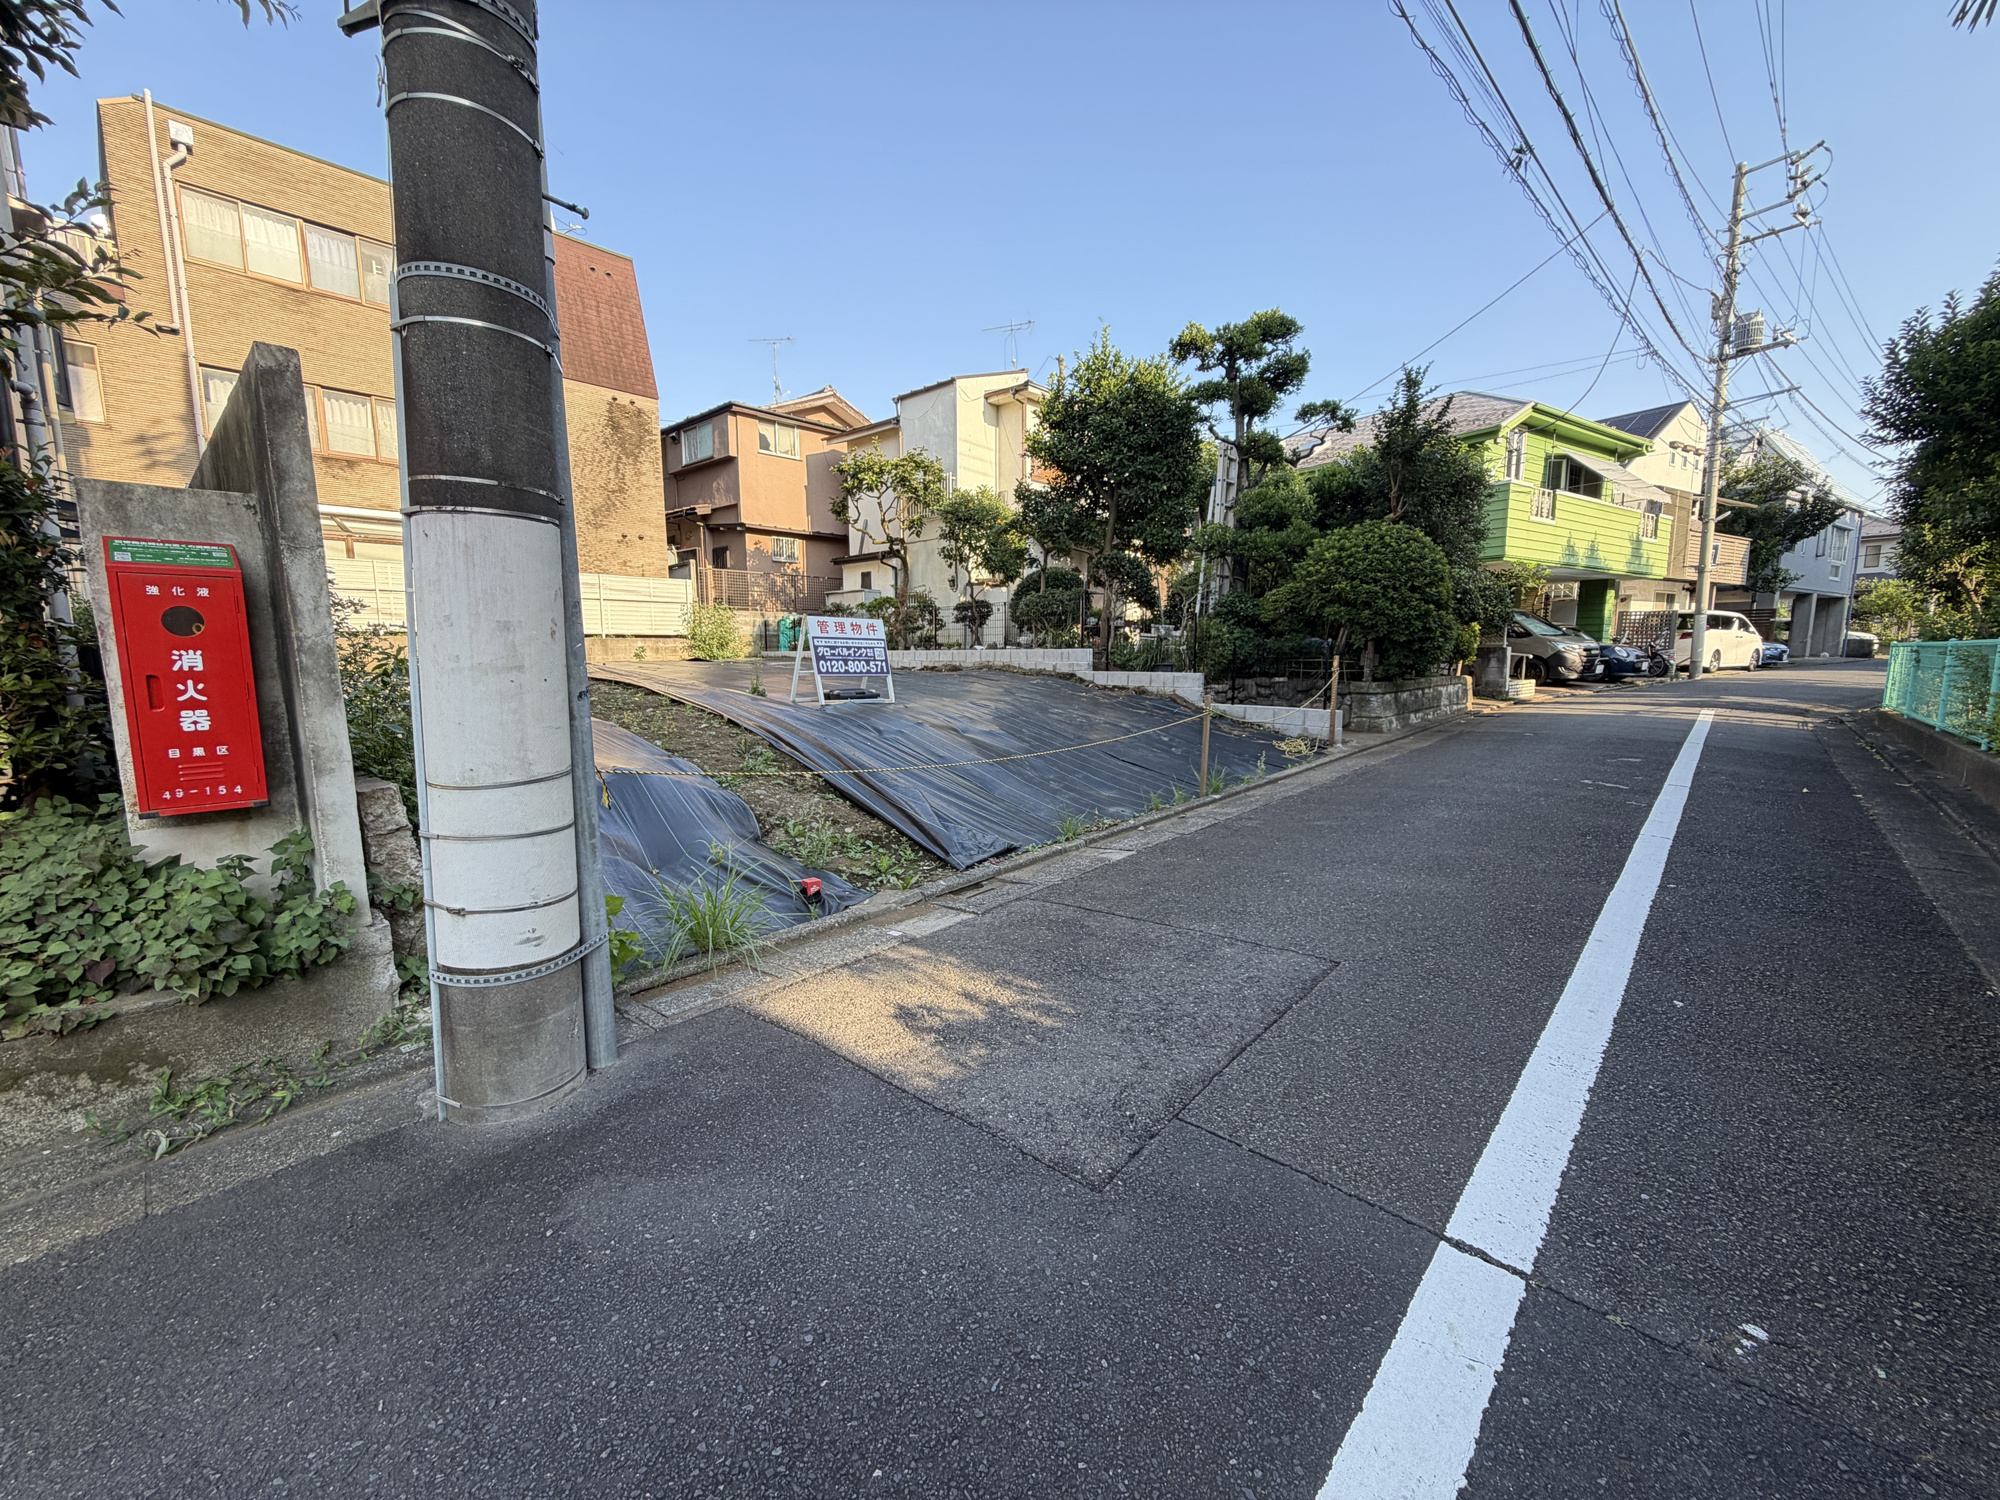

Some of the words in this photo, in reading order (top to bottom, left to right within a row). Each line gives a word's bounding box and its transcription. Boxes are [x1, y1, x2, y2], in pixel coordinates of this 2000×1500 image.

[145, 585, 210, 597] 強化液
[816, 620, 878, 635] 管理物件
[817, 646, 867, 657] グローバルインク
[819, 660, 887, 672] 0120-800-571
[171, 650, 211, 732] 消火器
[168, 745, 229, 758] 目黒区
[162, 784, 243, 800] 49-154
